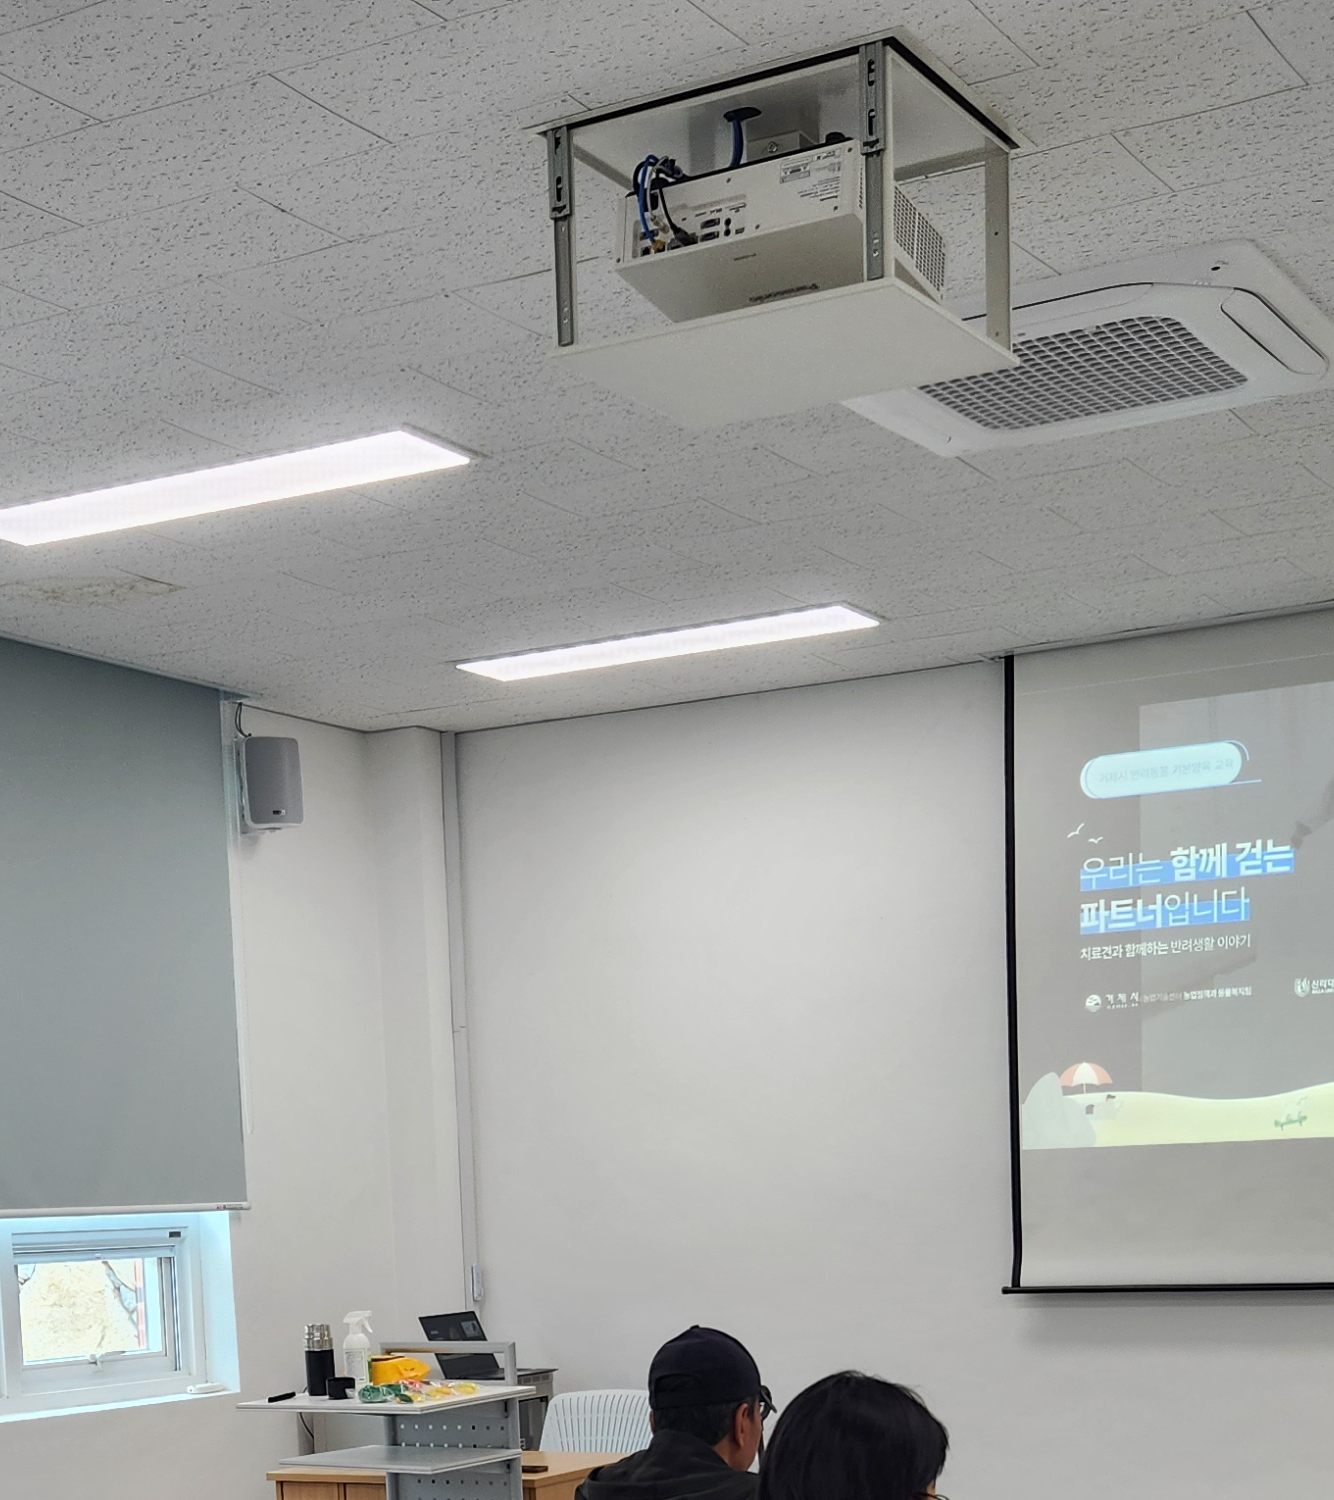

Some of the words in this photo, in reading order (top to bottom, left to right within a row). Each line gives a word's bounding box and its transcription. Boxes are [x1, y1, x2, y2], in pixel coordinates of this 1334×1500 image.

[1080, 852, 1163, 891] 우리는
[1170, 842, 1228, 882] 함께
[1235, 839, 1294, 876] 걷는
[1080, 886, 1250, 933] 파트너입니다
[1080, 946, 1124, 961] 치료견과
[1125, 941, 1168, 958] 함께하는
[1170, 937, 1215, 953] 반려생활
[1217, 934, 1251, 950] 이야기
